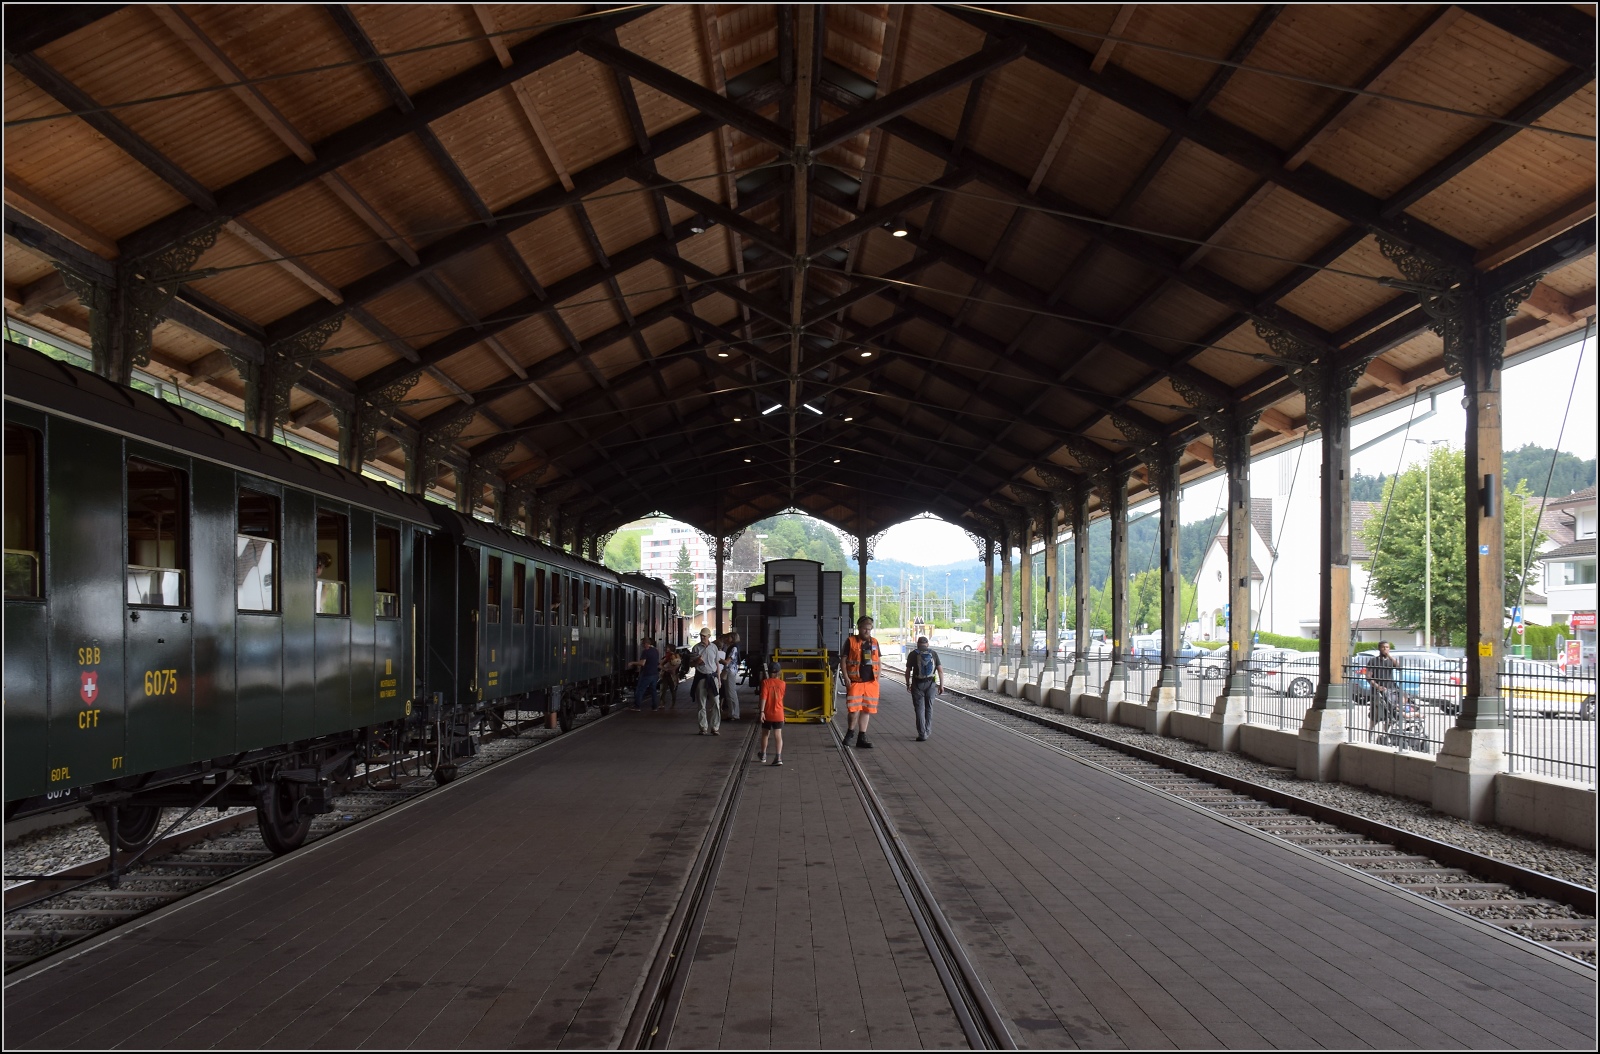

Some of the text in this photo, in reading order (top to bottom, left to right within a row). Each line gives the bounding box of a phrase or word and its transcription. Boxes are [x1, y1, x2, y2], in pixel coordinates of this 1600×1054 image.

[78, 647, 101, 665] SBB
[144, 669, 177, 697] 6075
[78, 709, 101, 729] CFF
[51, 766, 71, 782] 60 PL
